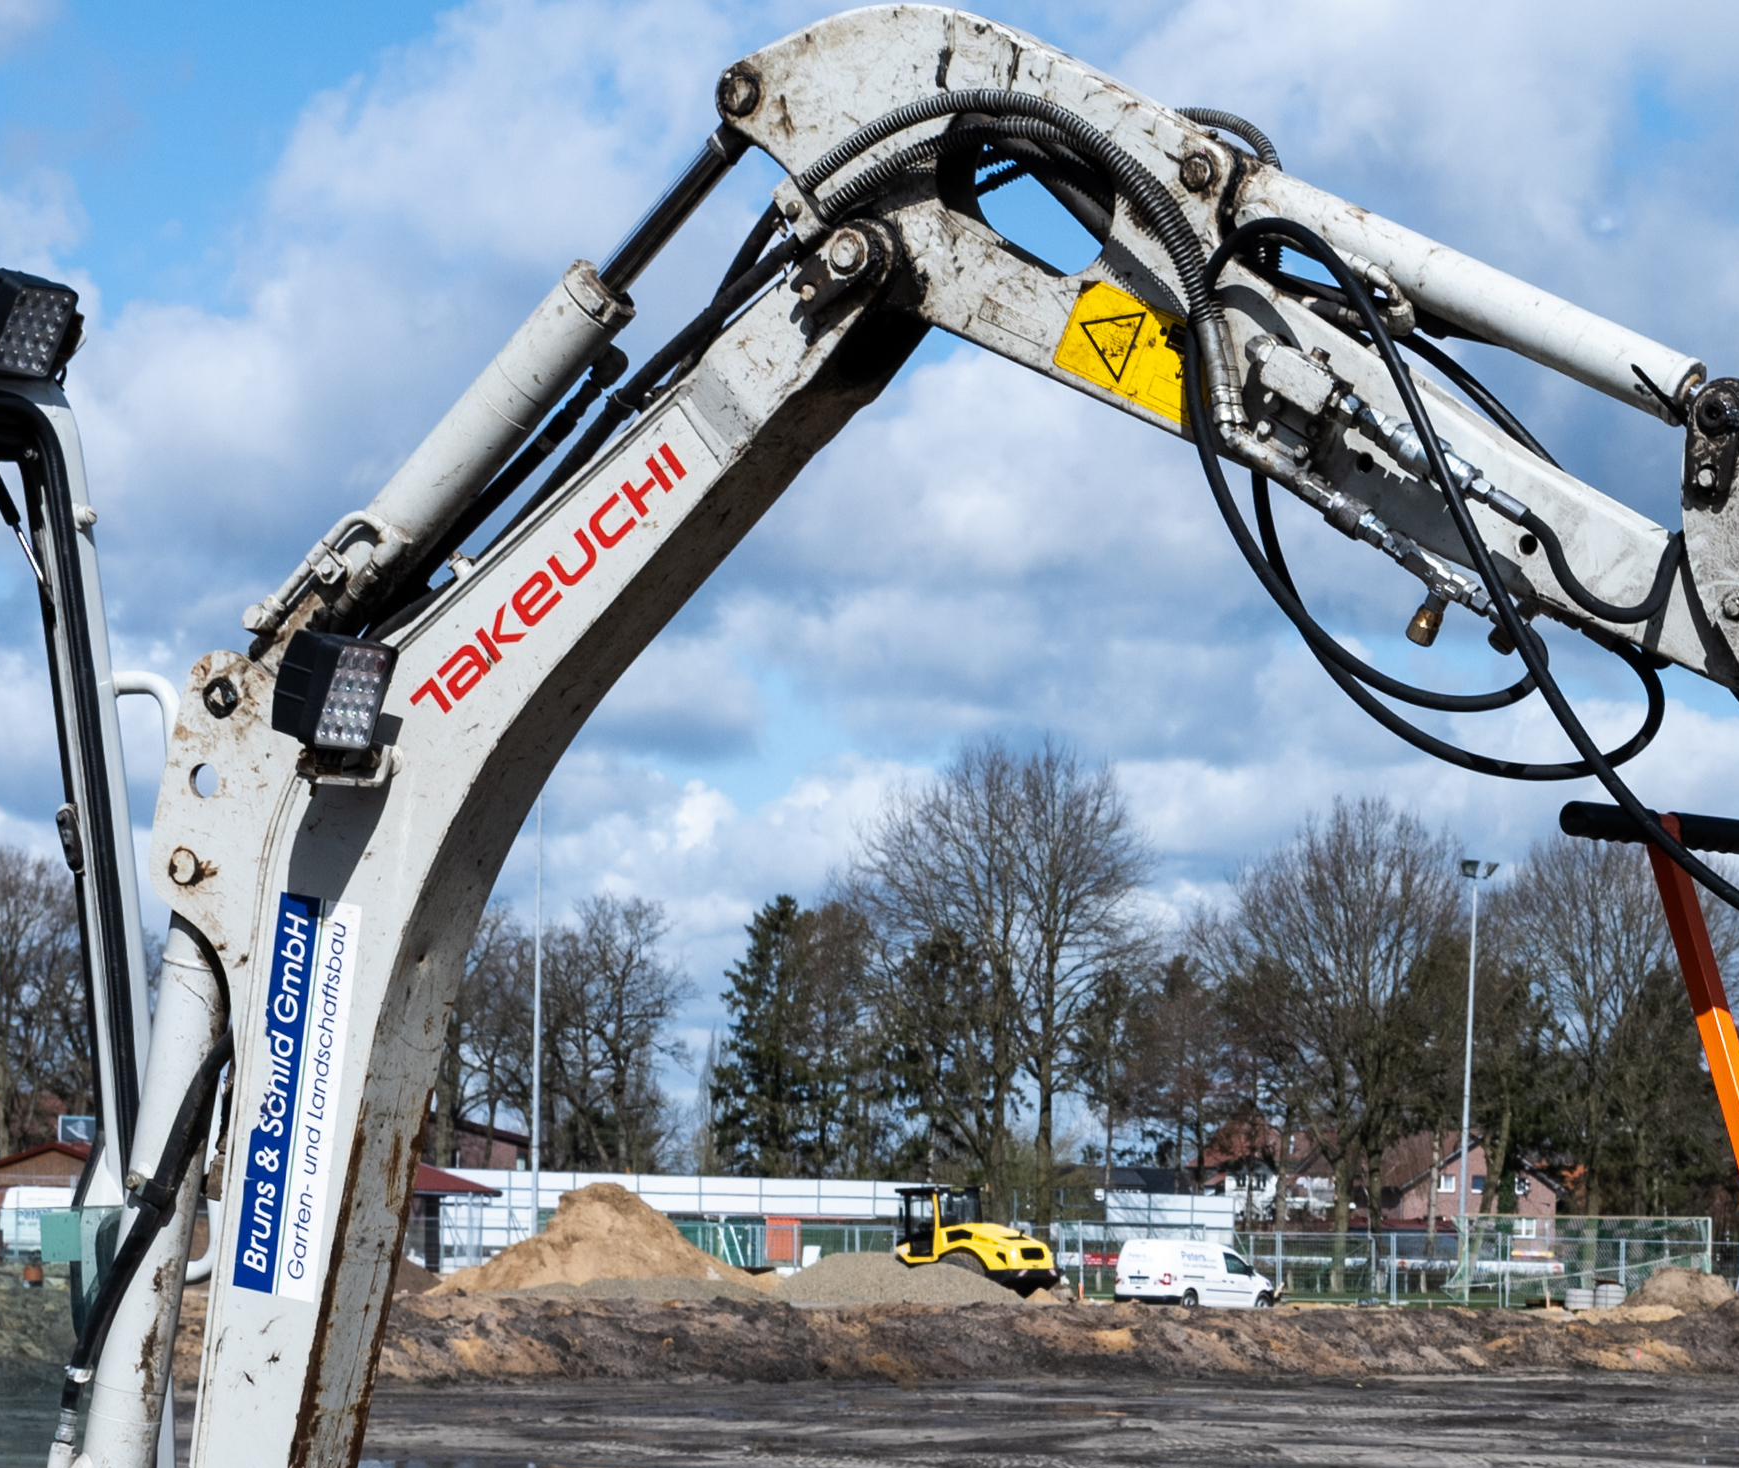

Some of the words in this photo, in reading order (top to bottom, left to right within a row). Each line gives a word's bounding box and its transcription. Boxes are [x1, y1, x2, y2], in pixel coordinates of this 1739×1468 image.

[274, 912, 309, 1024] GmbH
[260, 1030, 294, 1138] Schild
[288, 1184, 313, 1280] Garten-
[303, 1128, 321, 1175] und
[312, 922, 347, 1119] Landschaftsbau
[256, 1146, 280, 1172] &
[243, 1182, 276, 1273] Bruns
